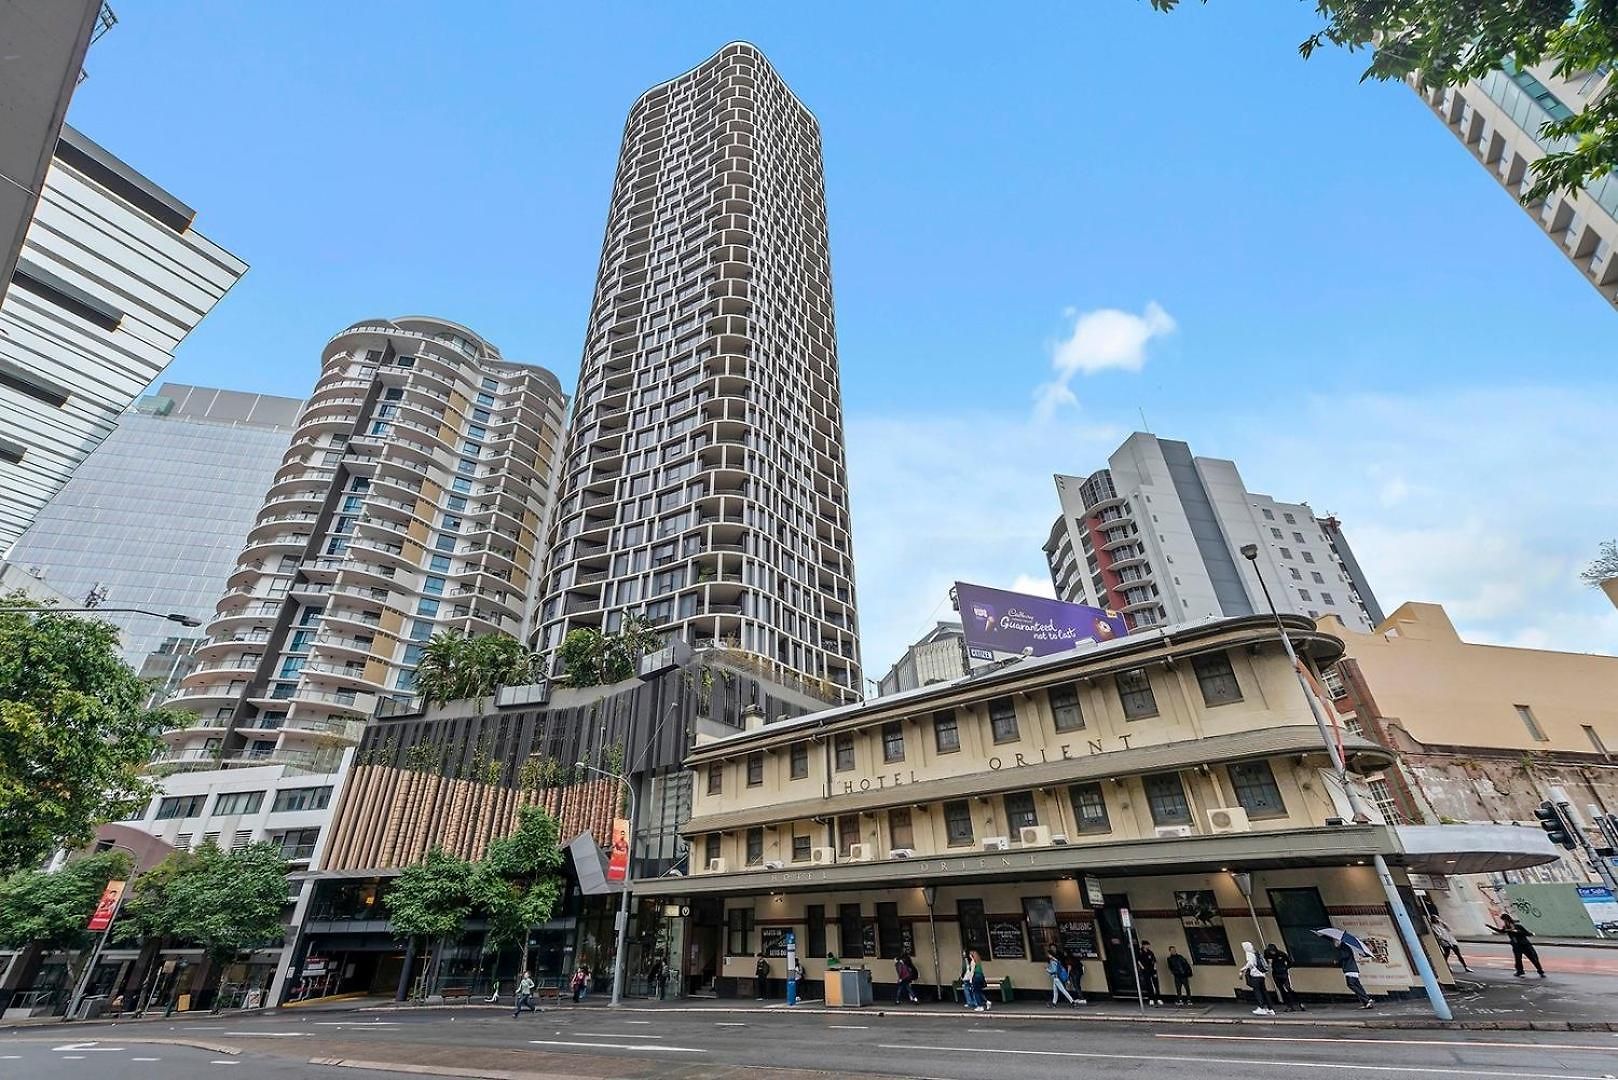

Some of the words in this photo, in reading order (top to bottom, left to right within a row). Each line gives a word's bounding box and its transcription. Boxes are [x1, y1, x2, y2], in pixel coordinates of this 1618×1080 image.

[1000, 616, 1057, 632] Guaranteed
[1033, 631, 1047, 640] not
[1048, 632, 1058, 640] to
[843, 769, 920, 794] HOTEL
[988, 733, 1133, 771] ORIENT
[770, 871, 828, 882] HOTEL
[919, 855, 1036, 872] ORIENT
